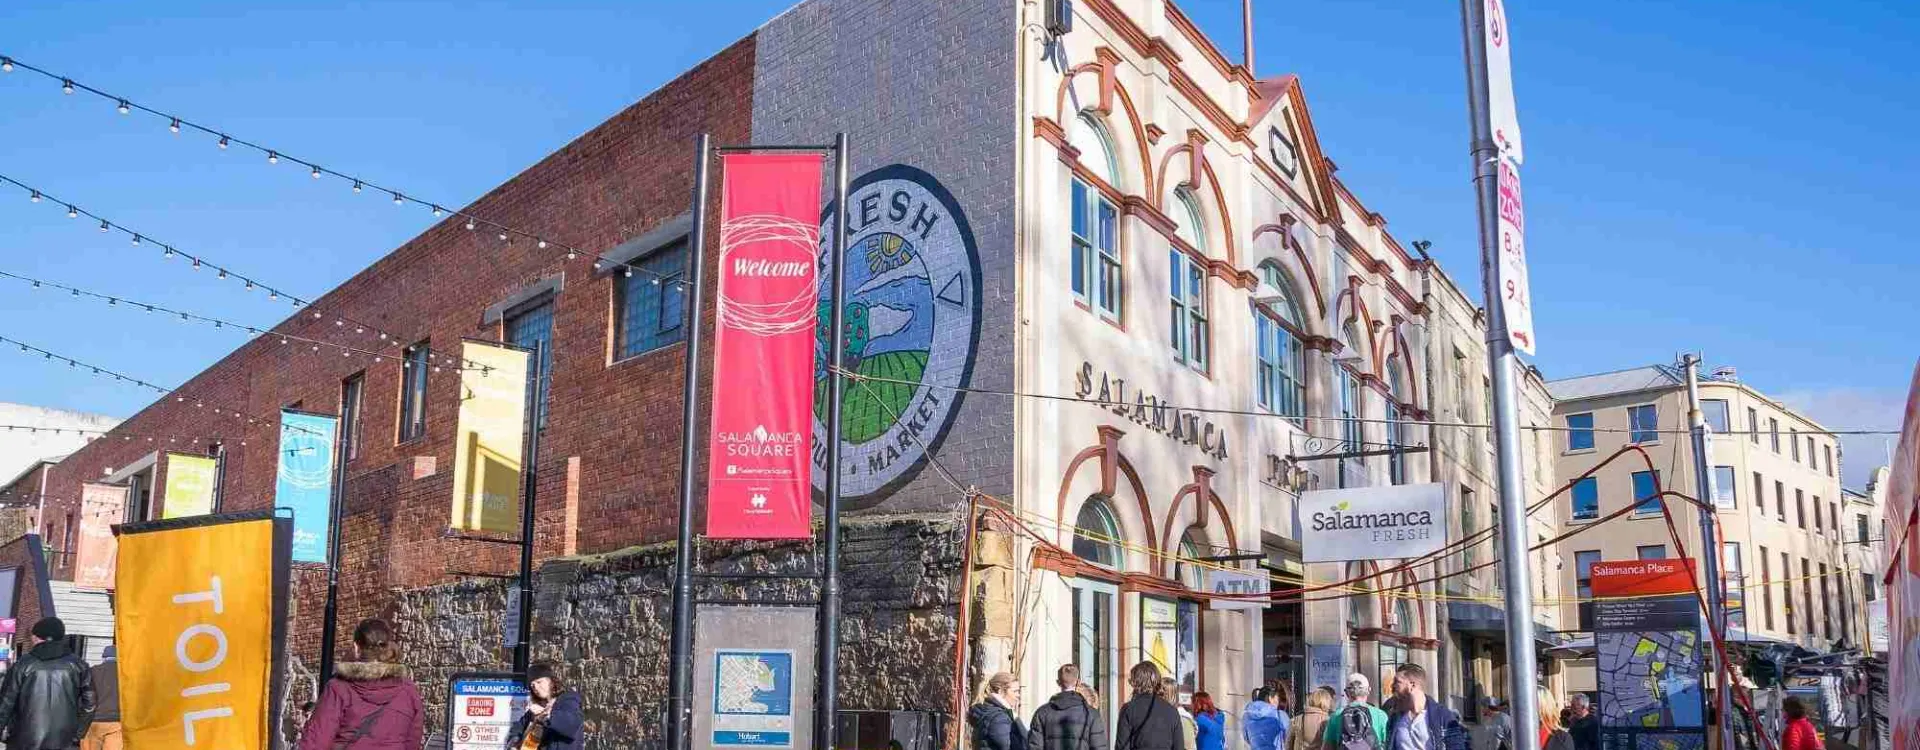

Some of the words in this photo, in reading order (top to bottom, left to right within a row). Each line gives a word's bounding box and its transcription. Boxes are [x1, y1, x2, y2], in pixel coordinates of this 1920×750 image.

[734, 258, 810, 277] Welcome
[1077, 361, 1228, 461] SALAMANCA
[718, 431, 803, 444] SALAMANCA
[868, 387, 940, 475] MARKET
[727, 444, 794, 457] SQUARE
[1313, 510, 1433, 532] Salamanca
[1372, 529, 1430, 542] FRESH
[1593, 565, 1645, 577] Salamanca
[1647, 562, 1675, 574] Place
[1215, 579, 1260, 595] ATM
[462, 685, 509, 693] SALAMANCA
[469, 707, 493, 716] ZONE
[474, 726, 500, 734] OTHER
